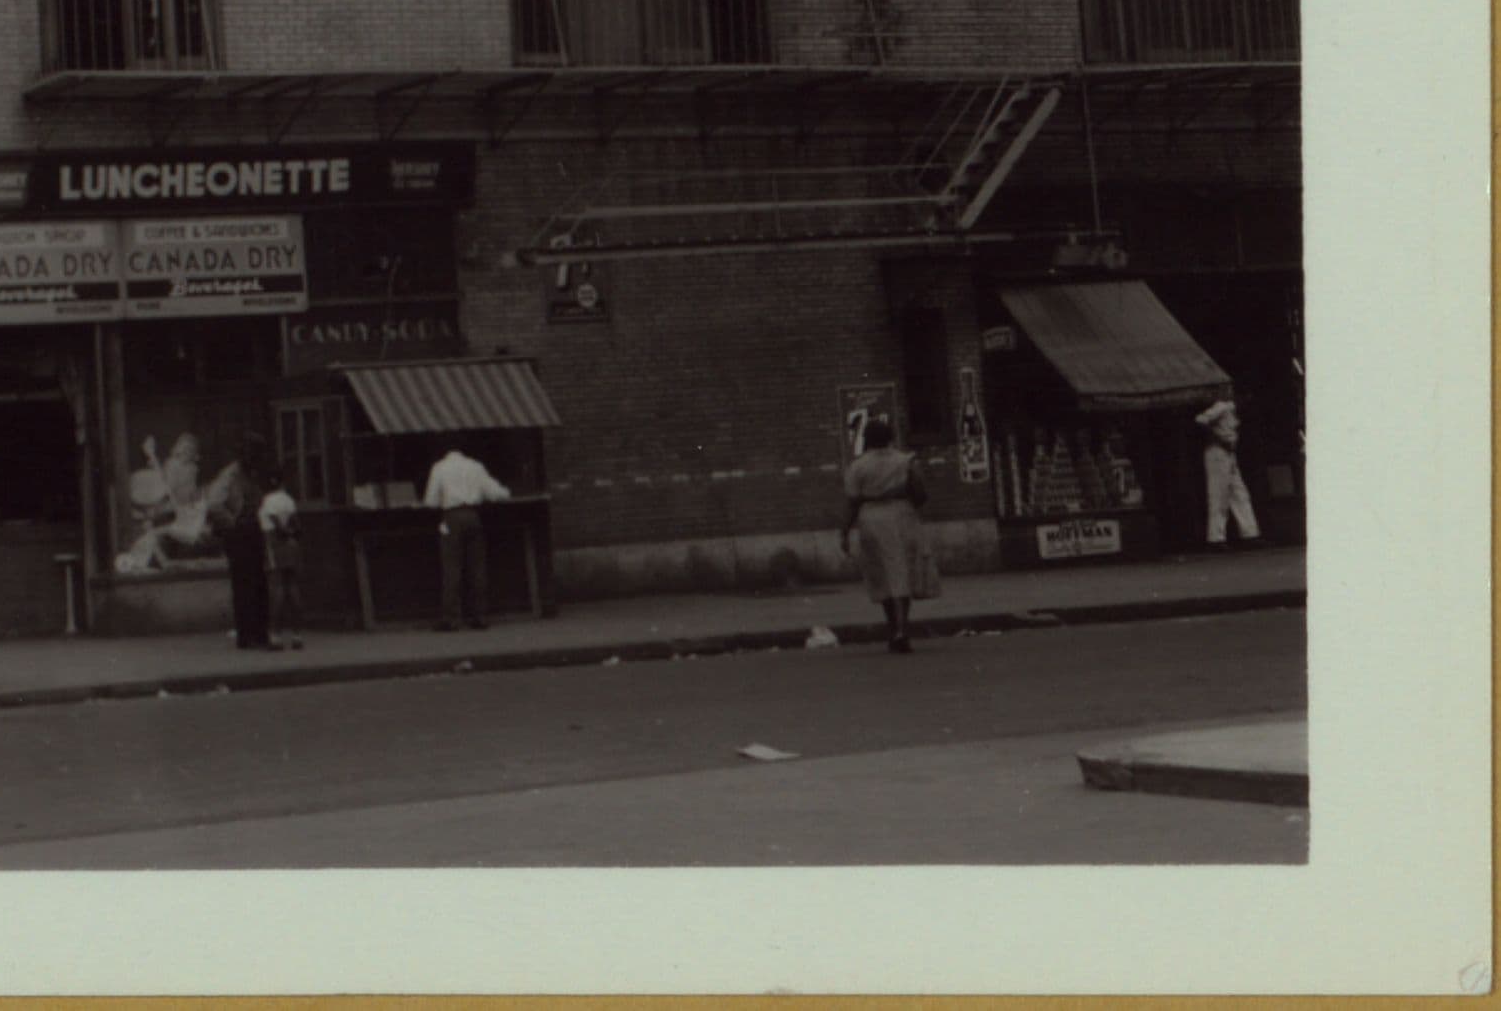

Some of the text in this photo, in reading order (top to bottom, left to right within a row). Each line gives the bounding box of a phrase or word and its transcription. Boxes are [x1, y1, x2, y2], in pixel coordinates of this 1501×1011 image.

[58, 158, 350, 200] LUNCHEONETTE
[61, 248, 116, 279] DRY
[128, 243, 298, 274] CANADA DRY
